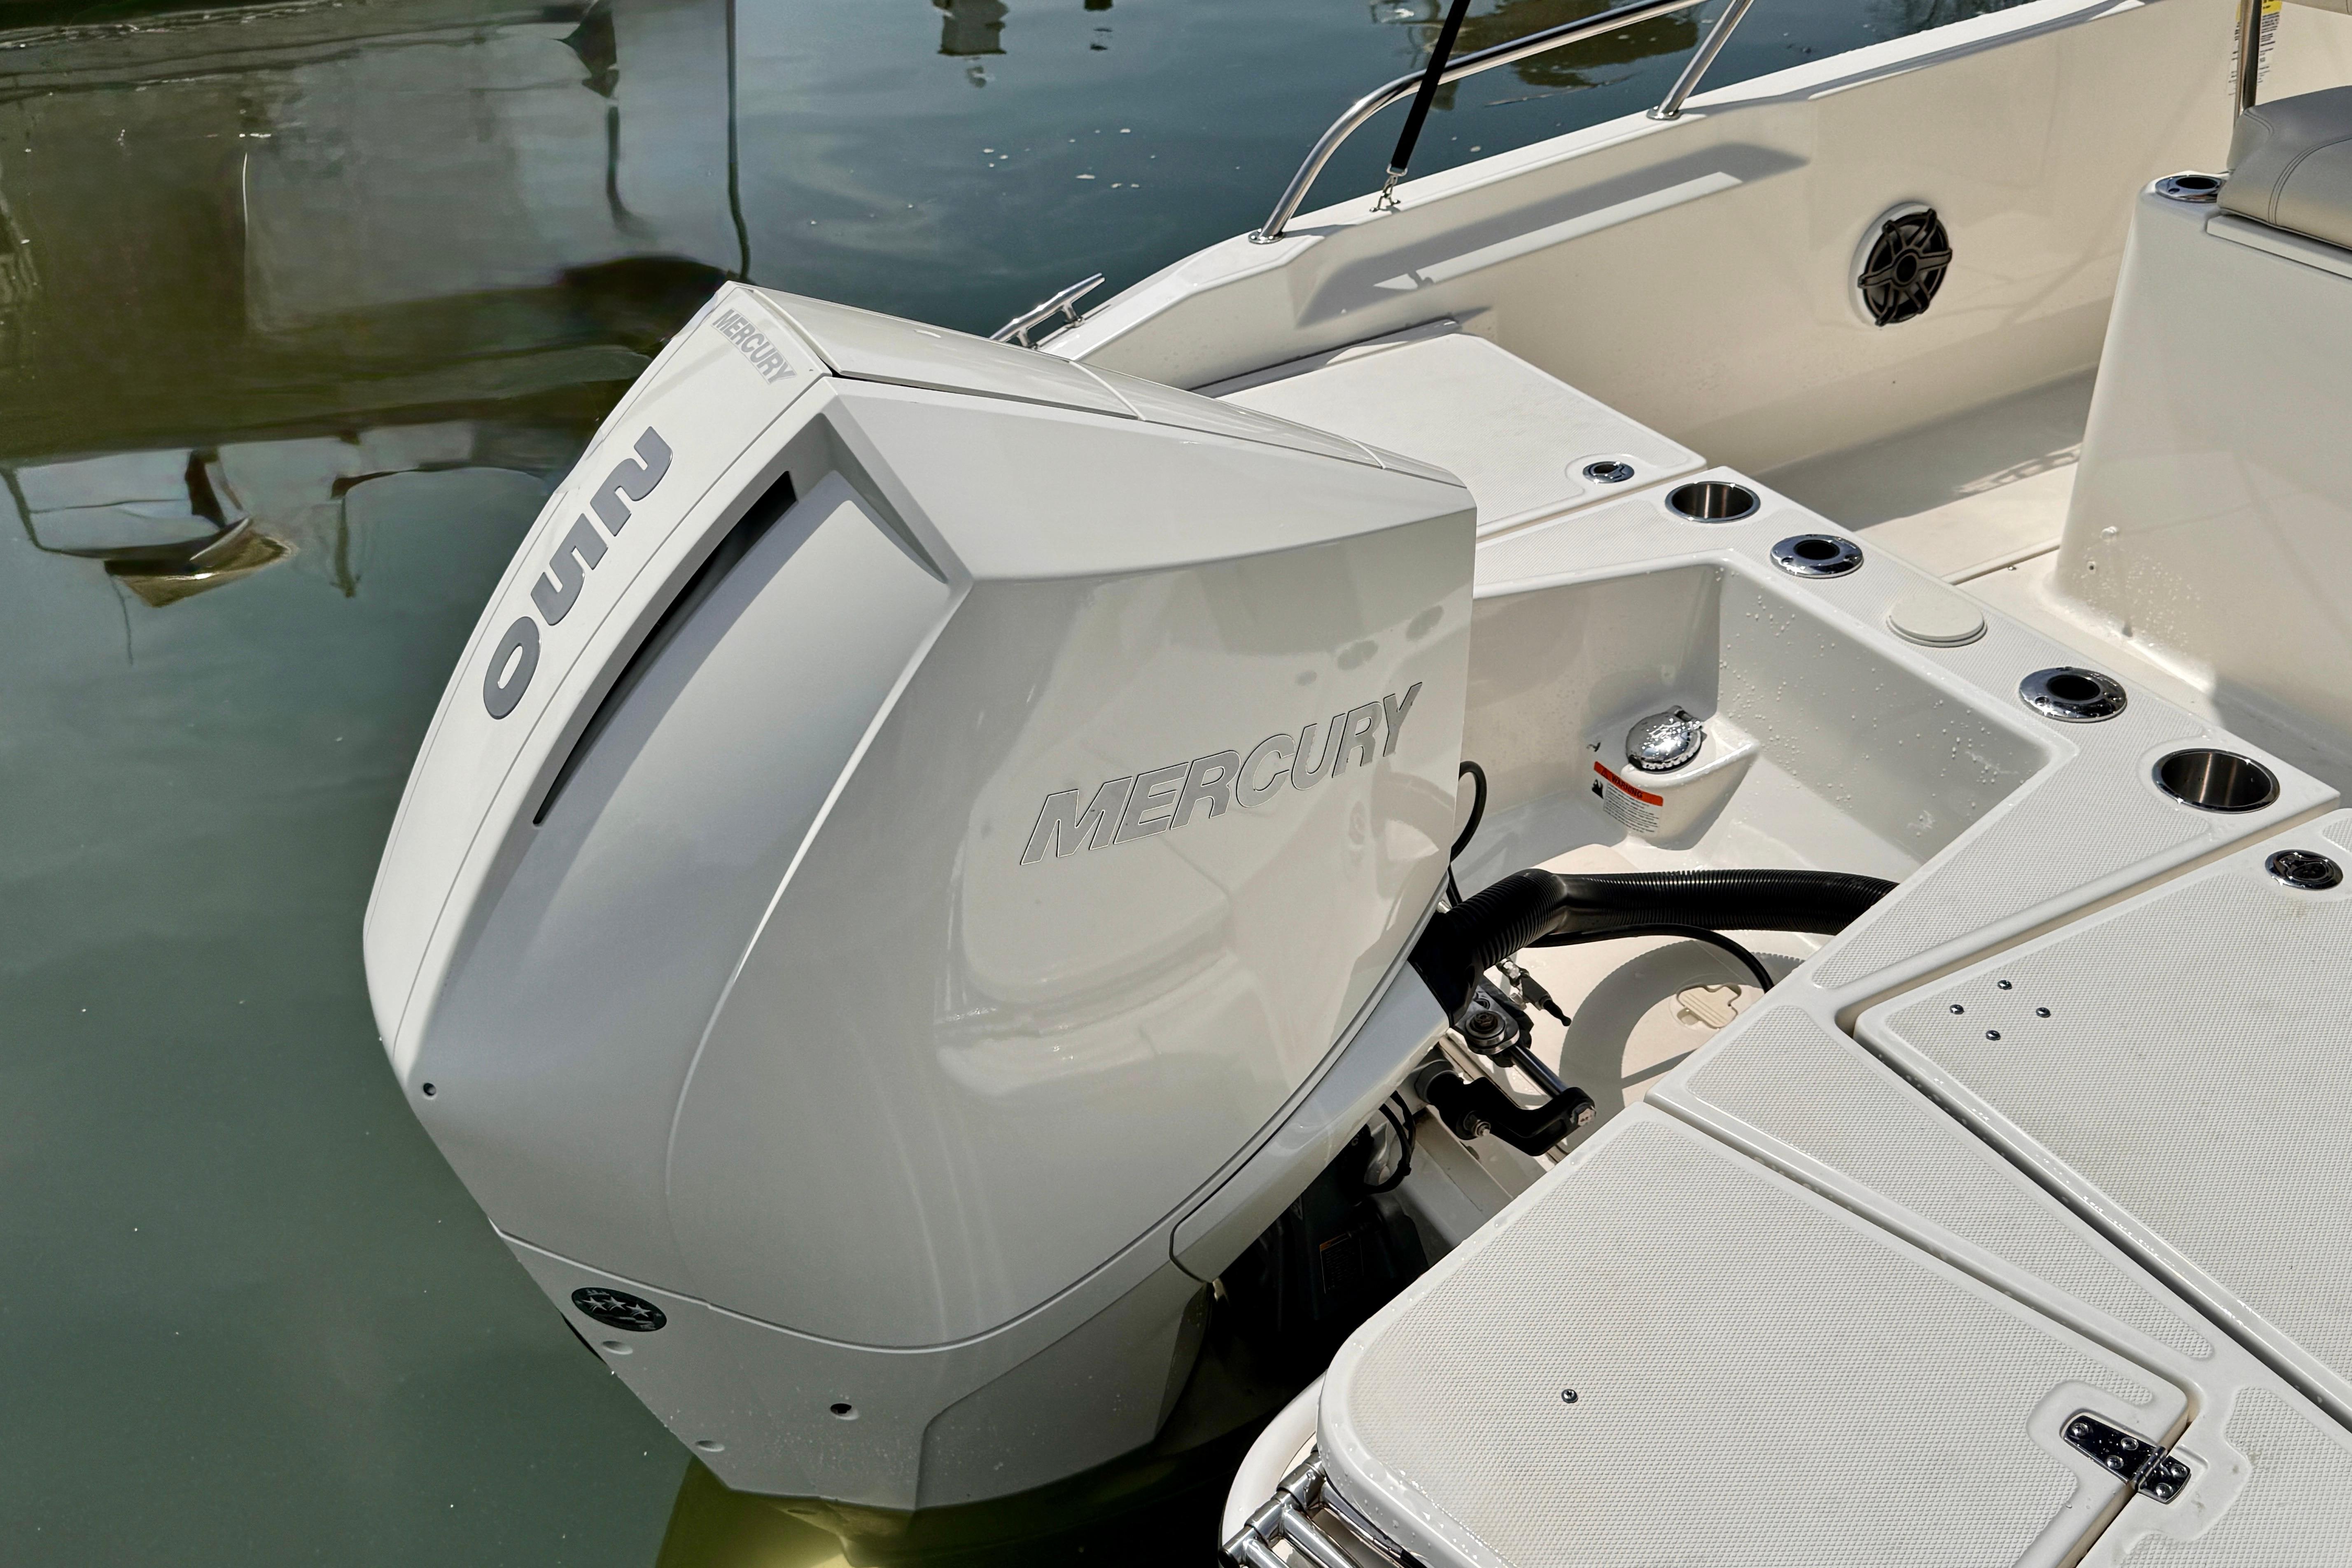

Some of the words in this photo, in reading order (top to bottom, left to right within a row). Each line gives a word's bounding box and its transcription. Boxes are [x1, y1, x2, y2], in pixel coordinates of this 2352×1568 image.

[712, 308, 797, 384] MERCURY
[483, 426, 673, 720] 250
[1020, 682, 1422, 865] MERCURY
[1612, 775, 1643, 798] WARNING
